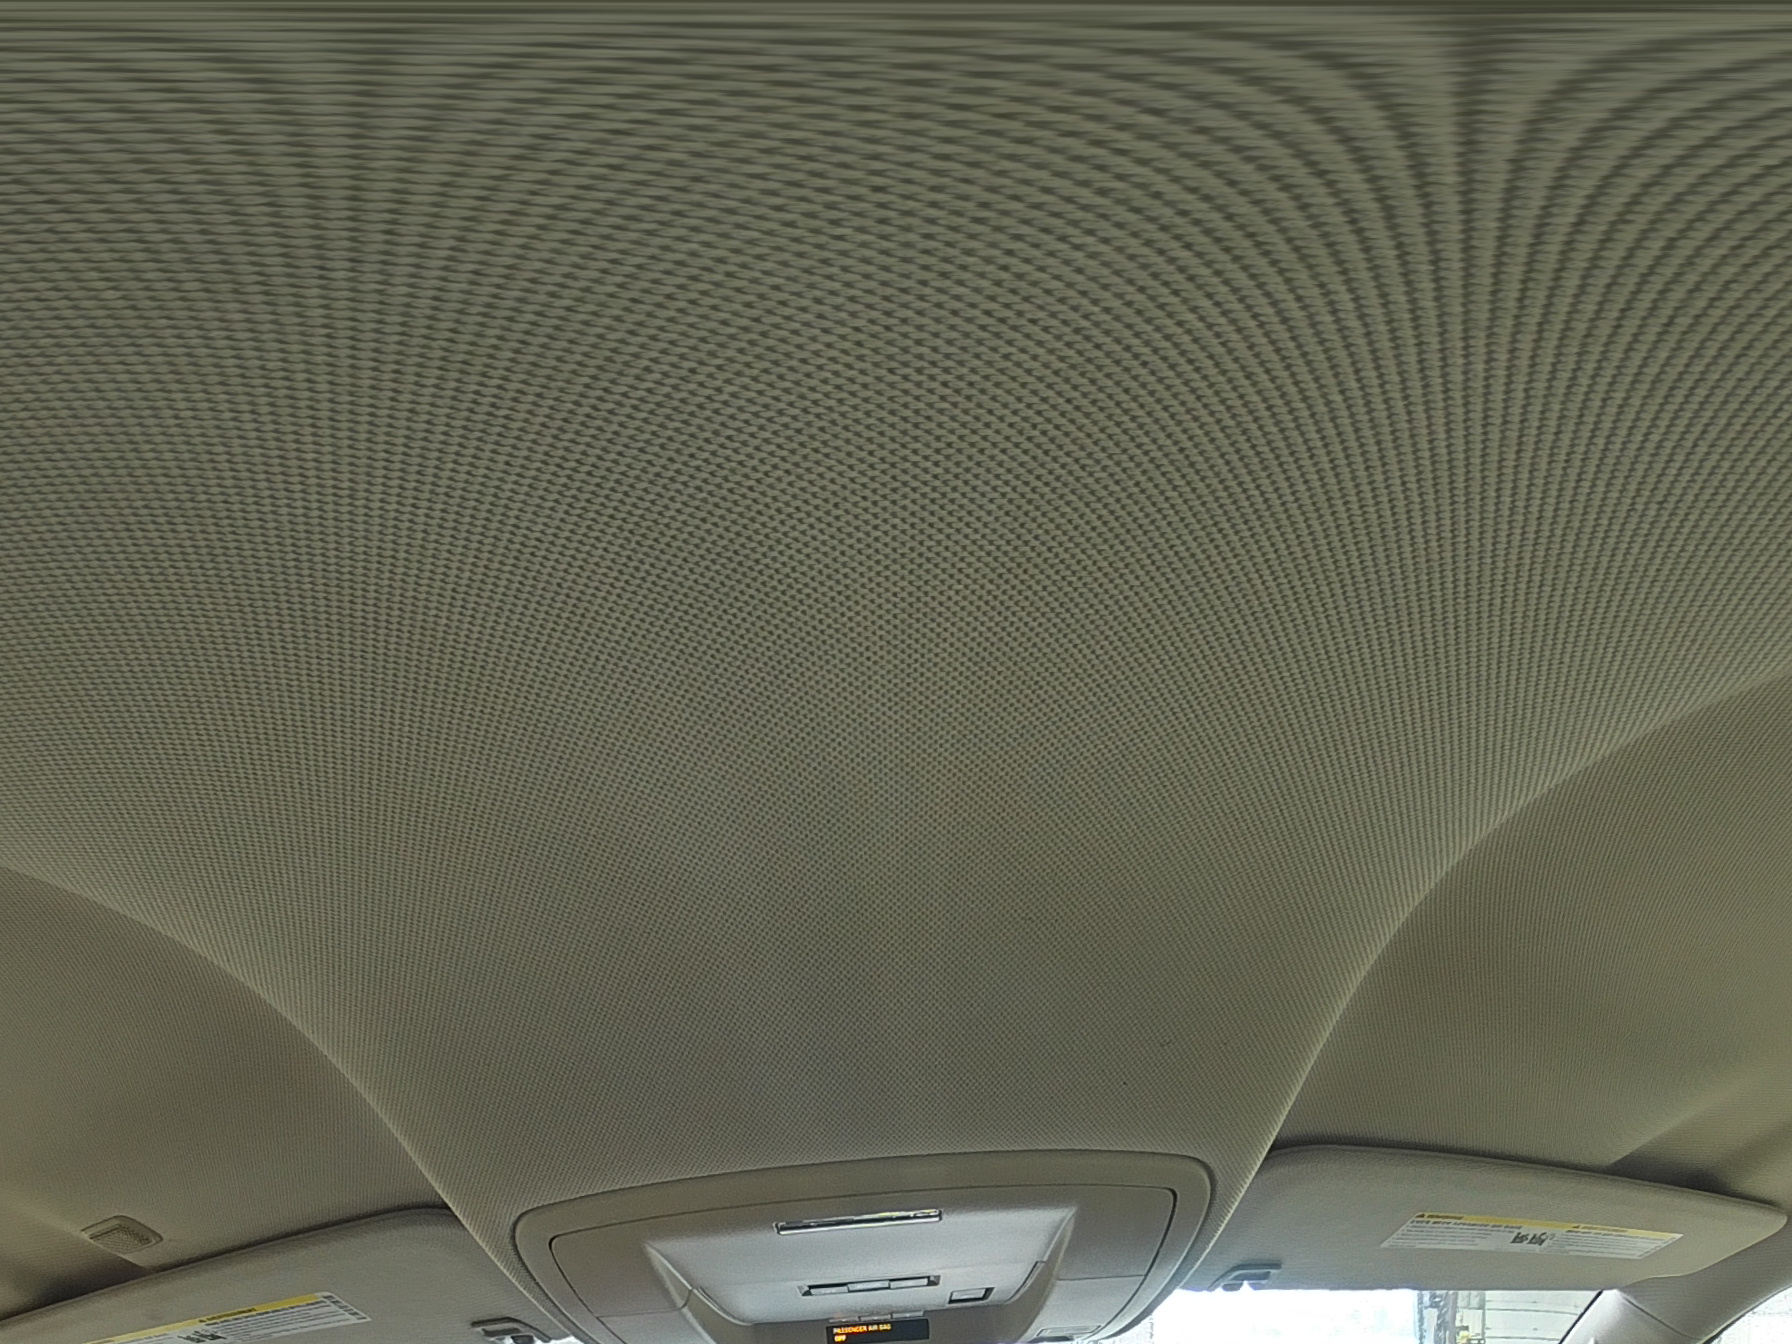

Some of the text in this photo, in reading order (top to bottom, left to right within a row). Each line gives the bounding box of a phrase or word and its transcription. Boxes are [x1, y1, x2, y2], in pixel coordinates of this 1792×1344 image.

[832, 1323, 892, 1334] PASSENGER AIR BAG
